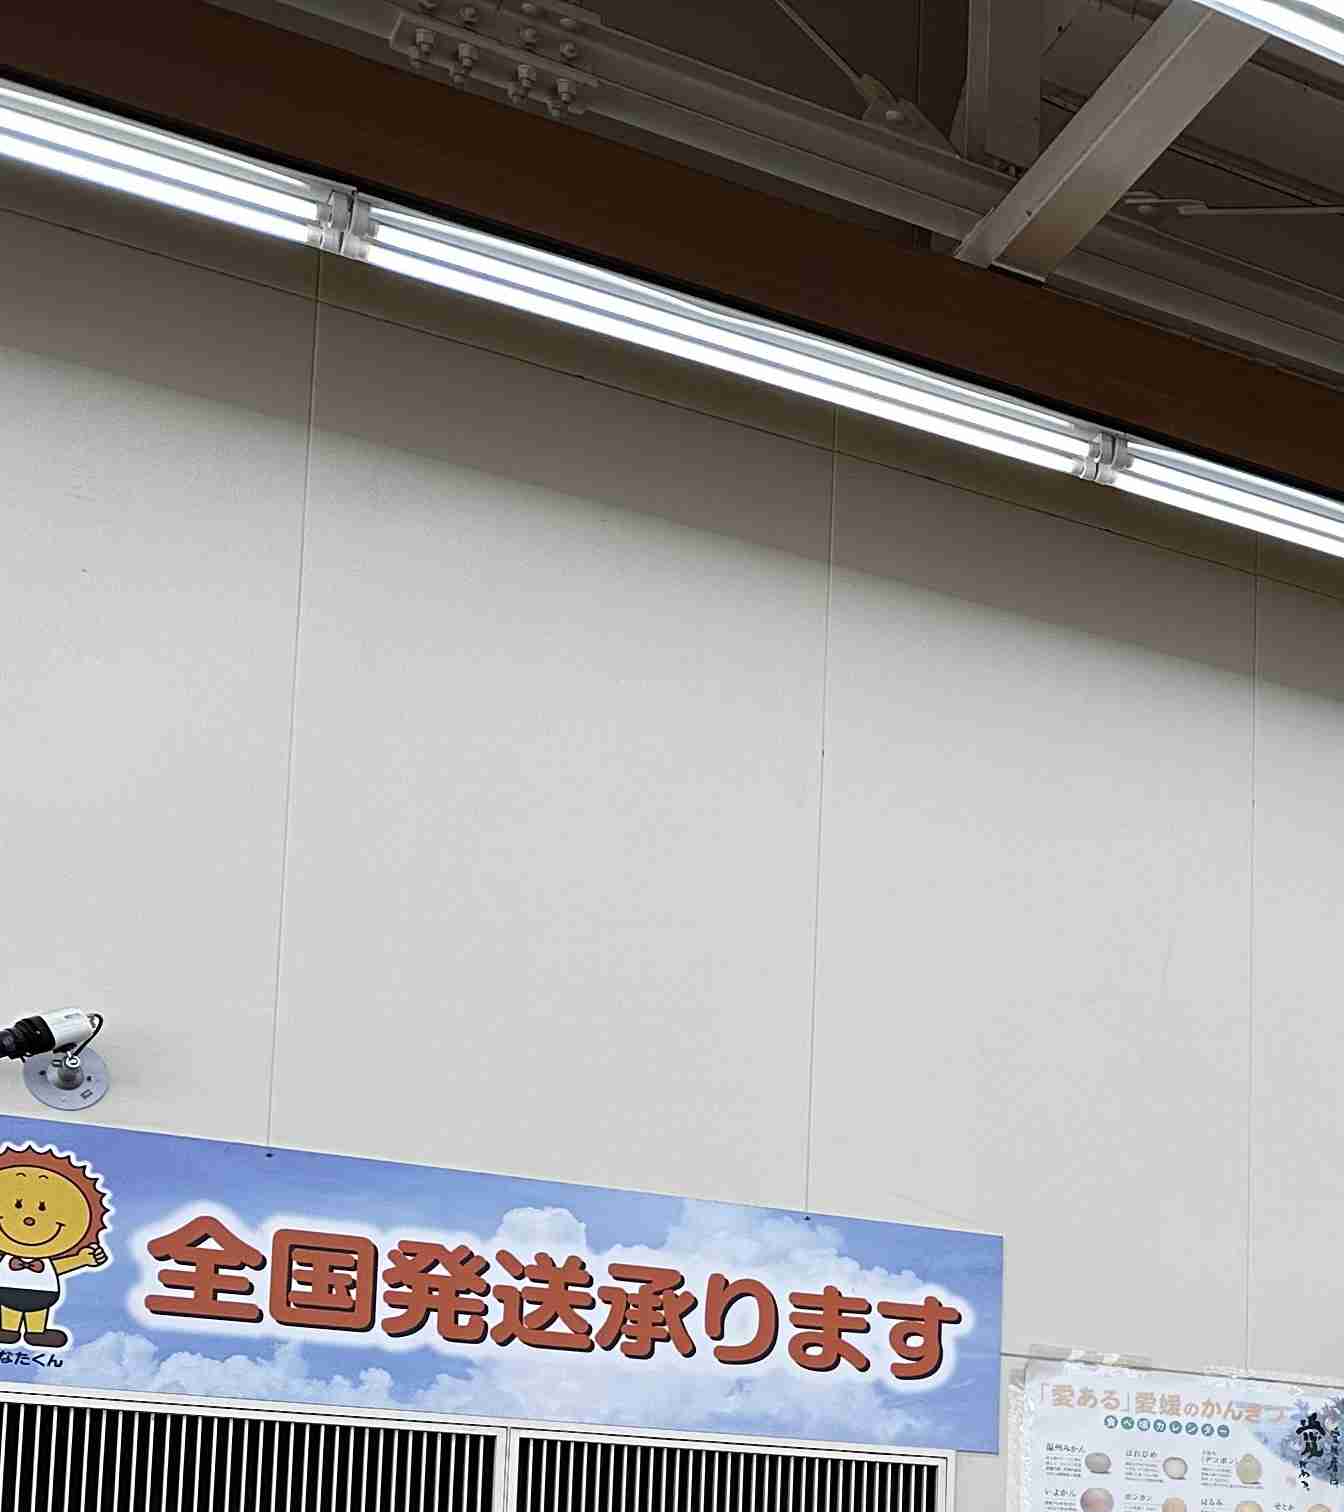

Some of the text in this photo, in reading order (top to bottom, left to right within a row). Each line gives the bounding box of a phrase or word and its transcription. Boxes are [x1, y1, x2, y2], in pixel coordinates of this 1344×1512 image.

[145, 1214, 963, 1380] 全国発送承ります
